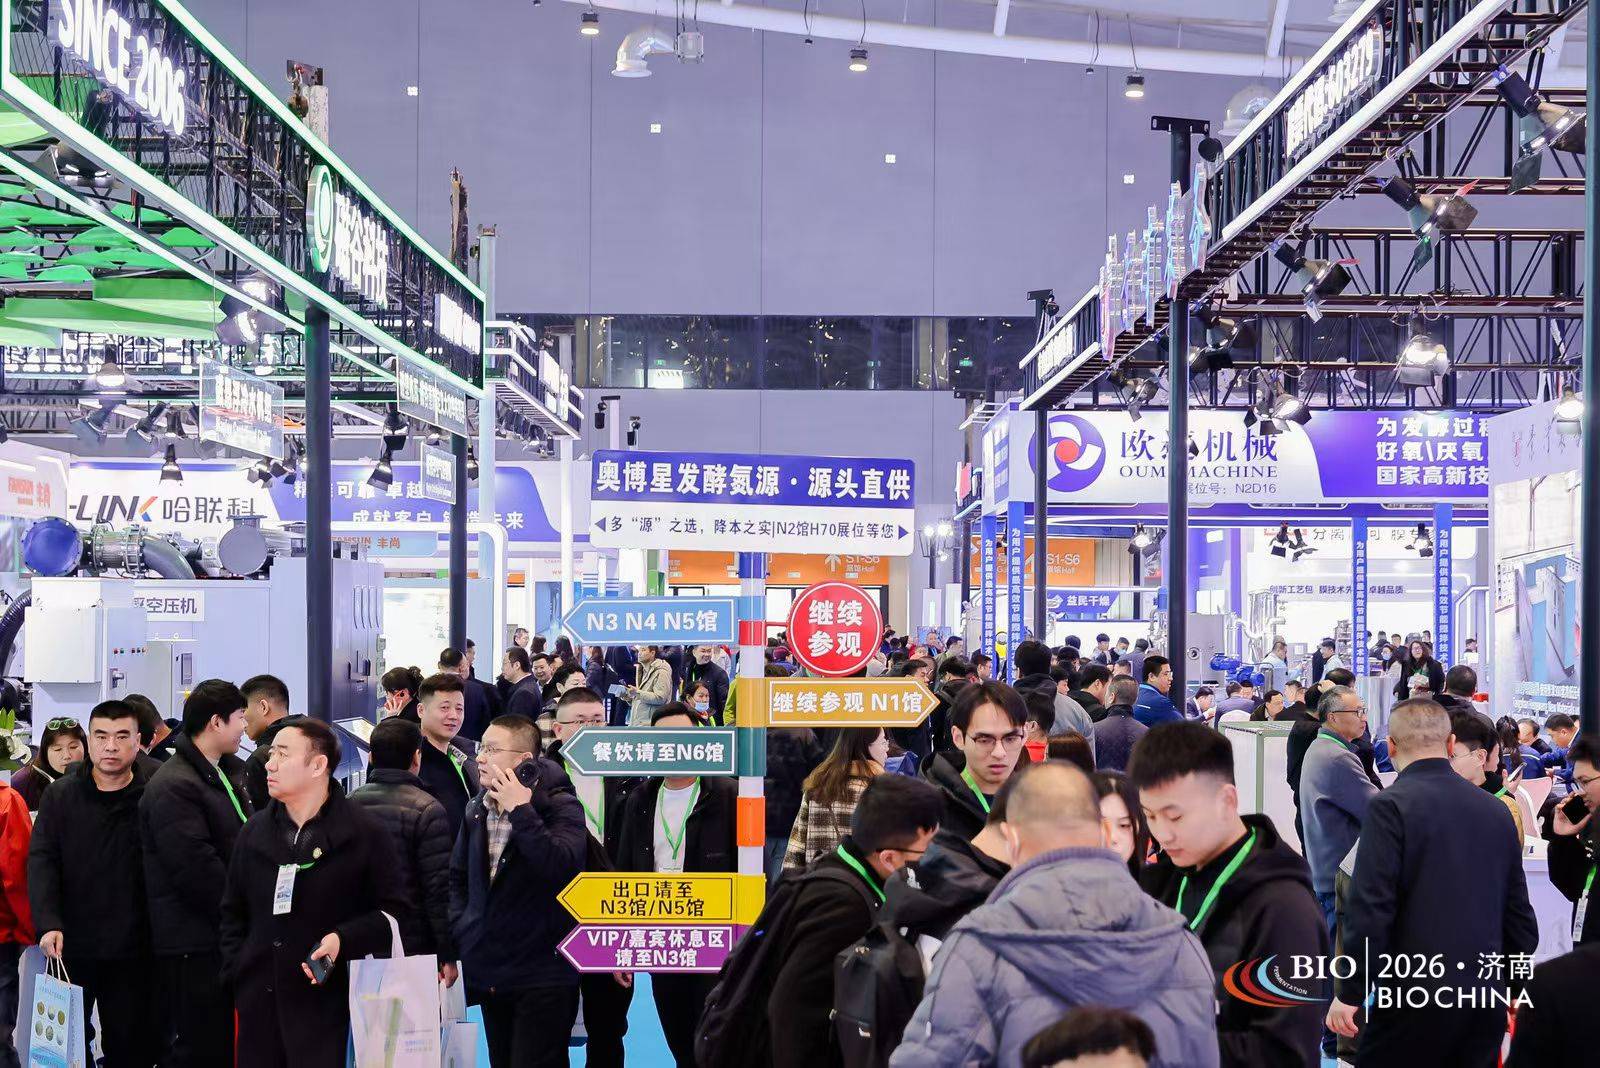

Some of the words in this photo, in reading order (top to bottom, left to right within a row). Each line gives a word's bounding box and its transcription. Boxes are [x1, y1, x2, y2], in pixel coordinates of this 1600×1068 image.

[58, 0, 131, 95] SINCE
[135, 35, 185, 136] 2006
[1120, 466, 1166, 478] OUM
[1376, 466, 1489, 486] 国家高新技
[1235, 483, 1277, 494] N2D16
[1047, 554, 1080, 565] S1-S6
[587, 613, 617, 631] N3
[625, 613, 657, 631] N4
[664, 610, 718, 633] N5馆
[808, 599, 863, 627] 继续
[808, 630, 862, 658] 参观
[773, 691, 866, 714] 继续参观
[871, 691, 923, 714] N1馆
[592, 741, 725, 763] 餐饮请至N6馆
[613, 881, 694, 899] 出口请至
[600, 898, 705, 917] N3馆/N5馆
[587, 929, 725, 949] VIP/嘉宾休息区
[615, 949, 698, 968] 请至N3馆
